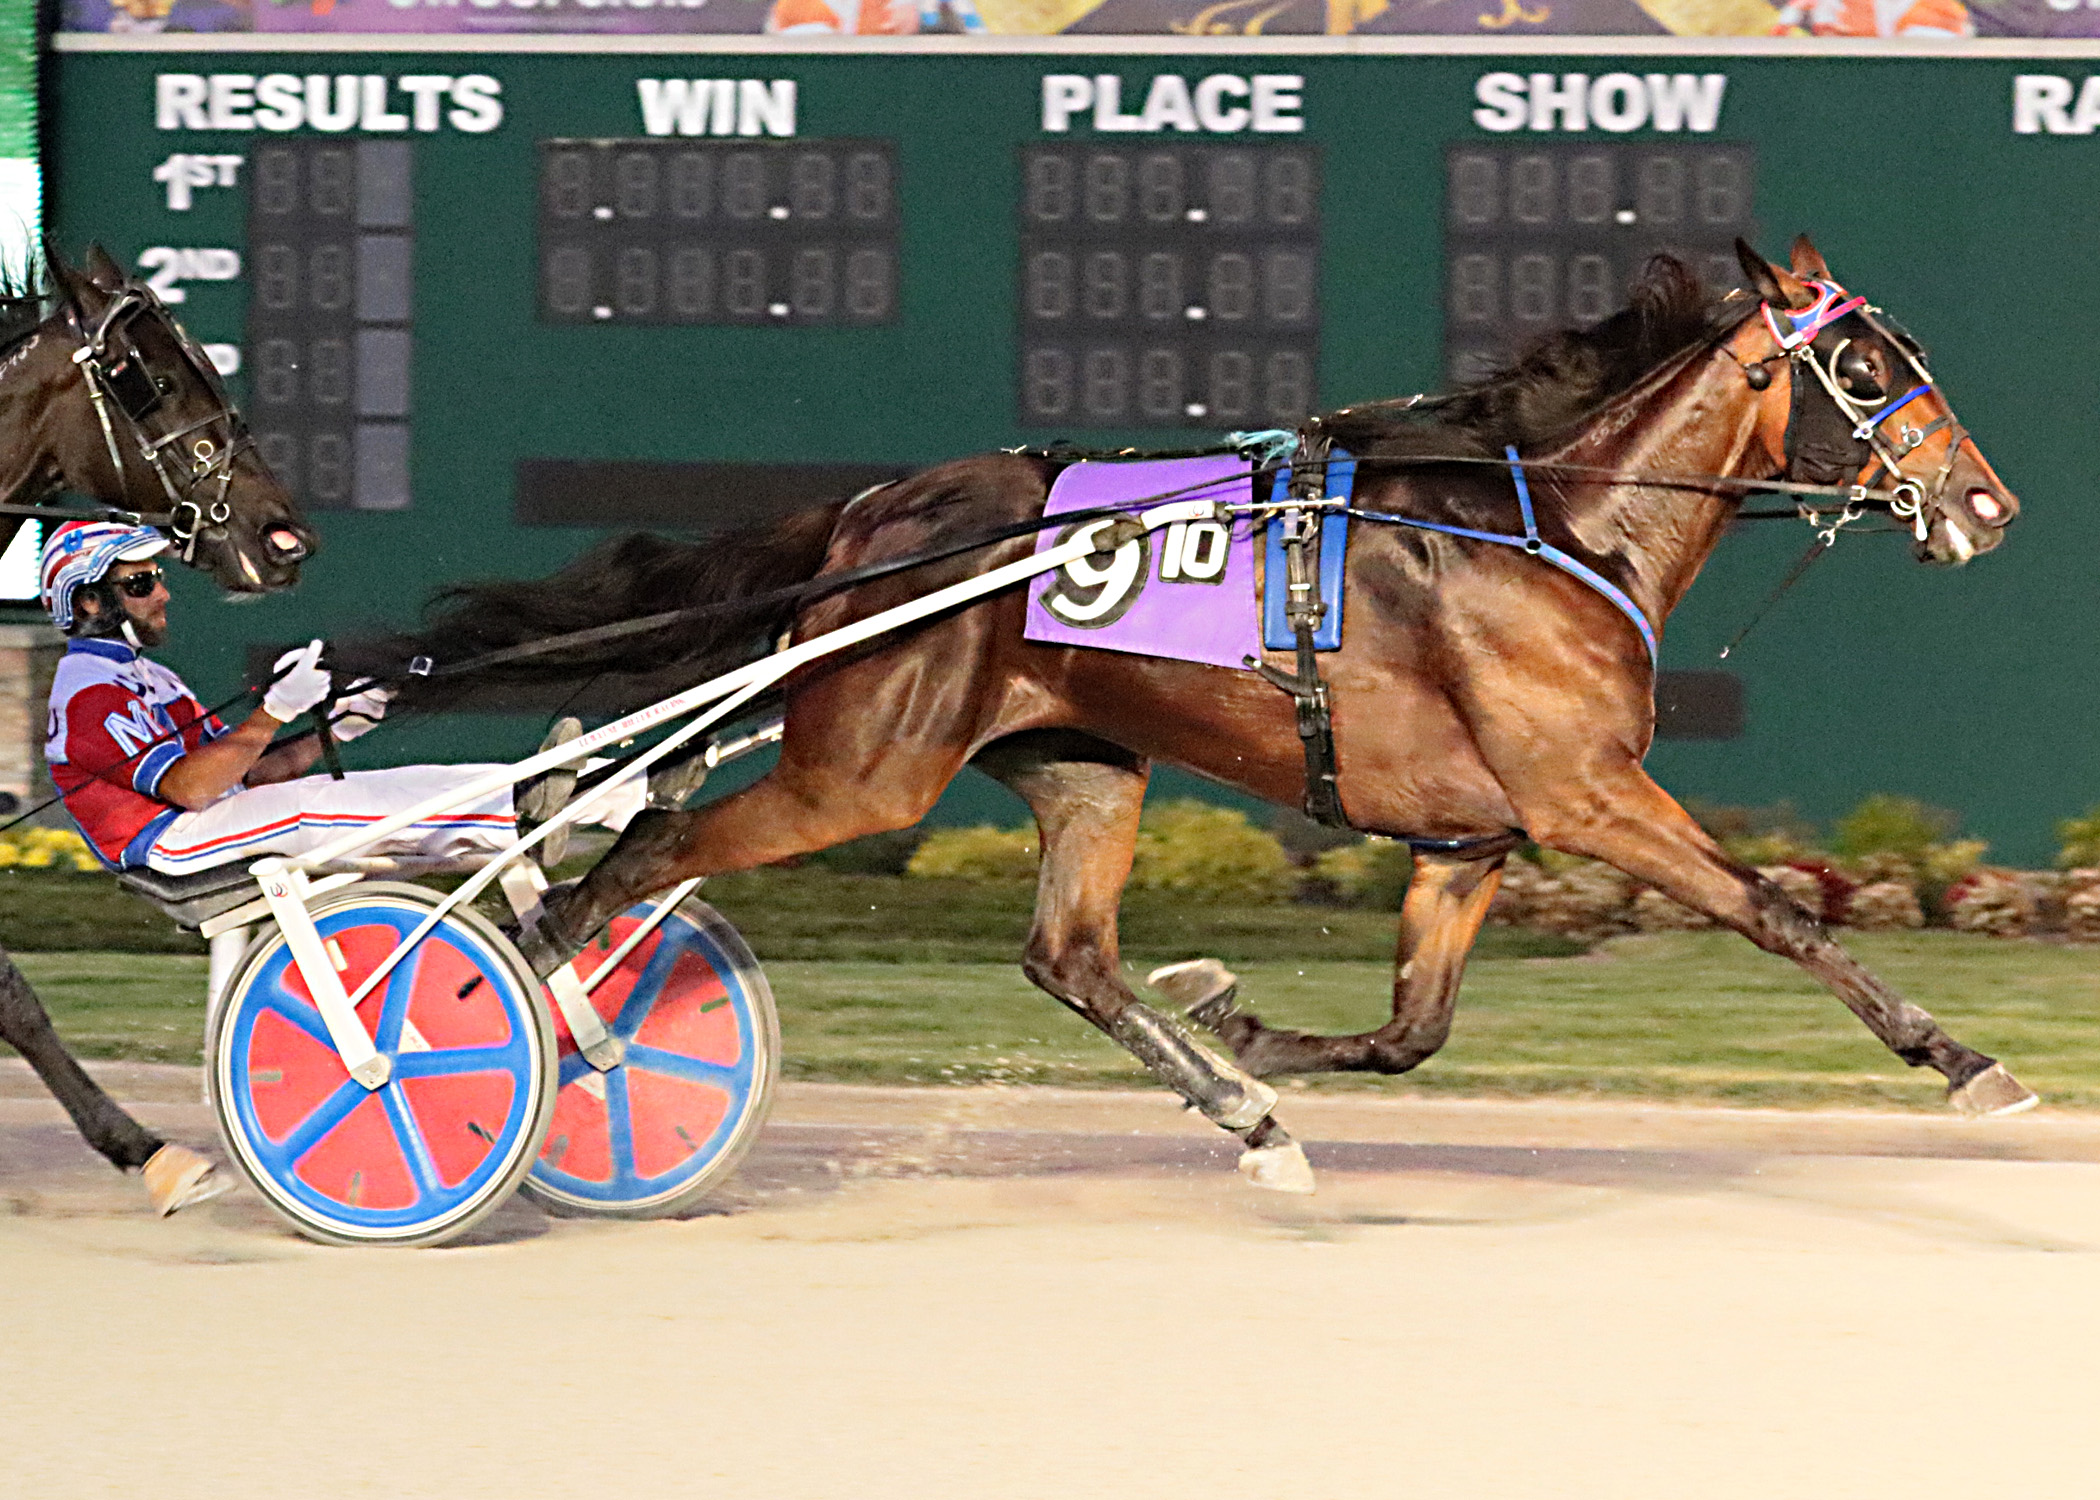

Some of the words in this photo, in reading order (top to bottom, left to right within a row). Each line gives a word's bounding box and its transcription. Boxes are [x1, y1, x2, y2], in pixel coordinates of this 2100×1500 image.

[156, 74, 502, 132] RESULTS
[637, 79, 797, 136] WIN
[1041, 75, 1304, 132] PLACE
[1474, 73, 1725, 132] SHOW
[153, 154, 244, 210] 1ST
[138, 247, 240, 303] 2ND
[1051, 516, 1142, 620] 9
[1160, 520, 1229, 578] 10
